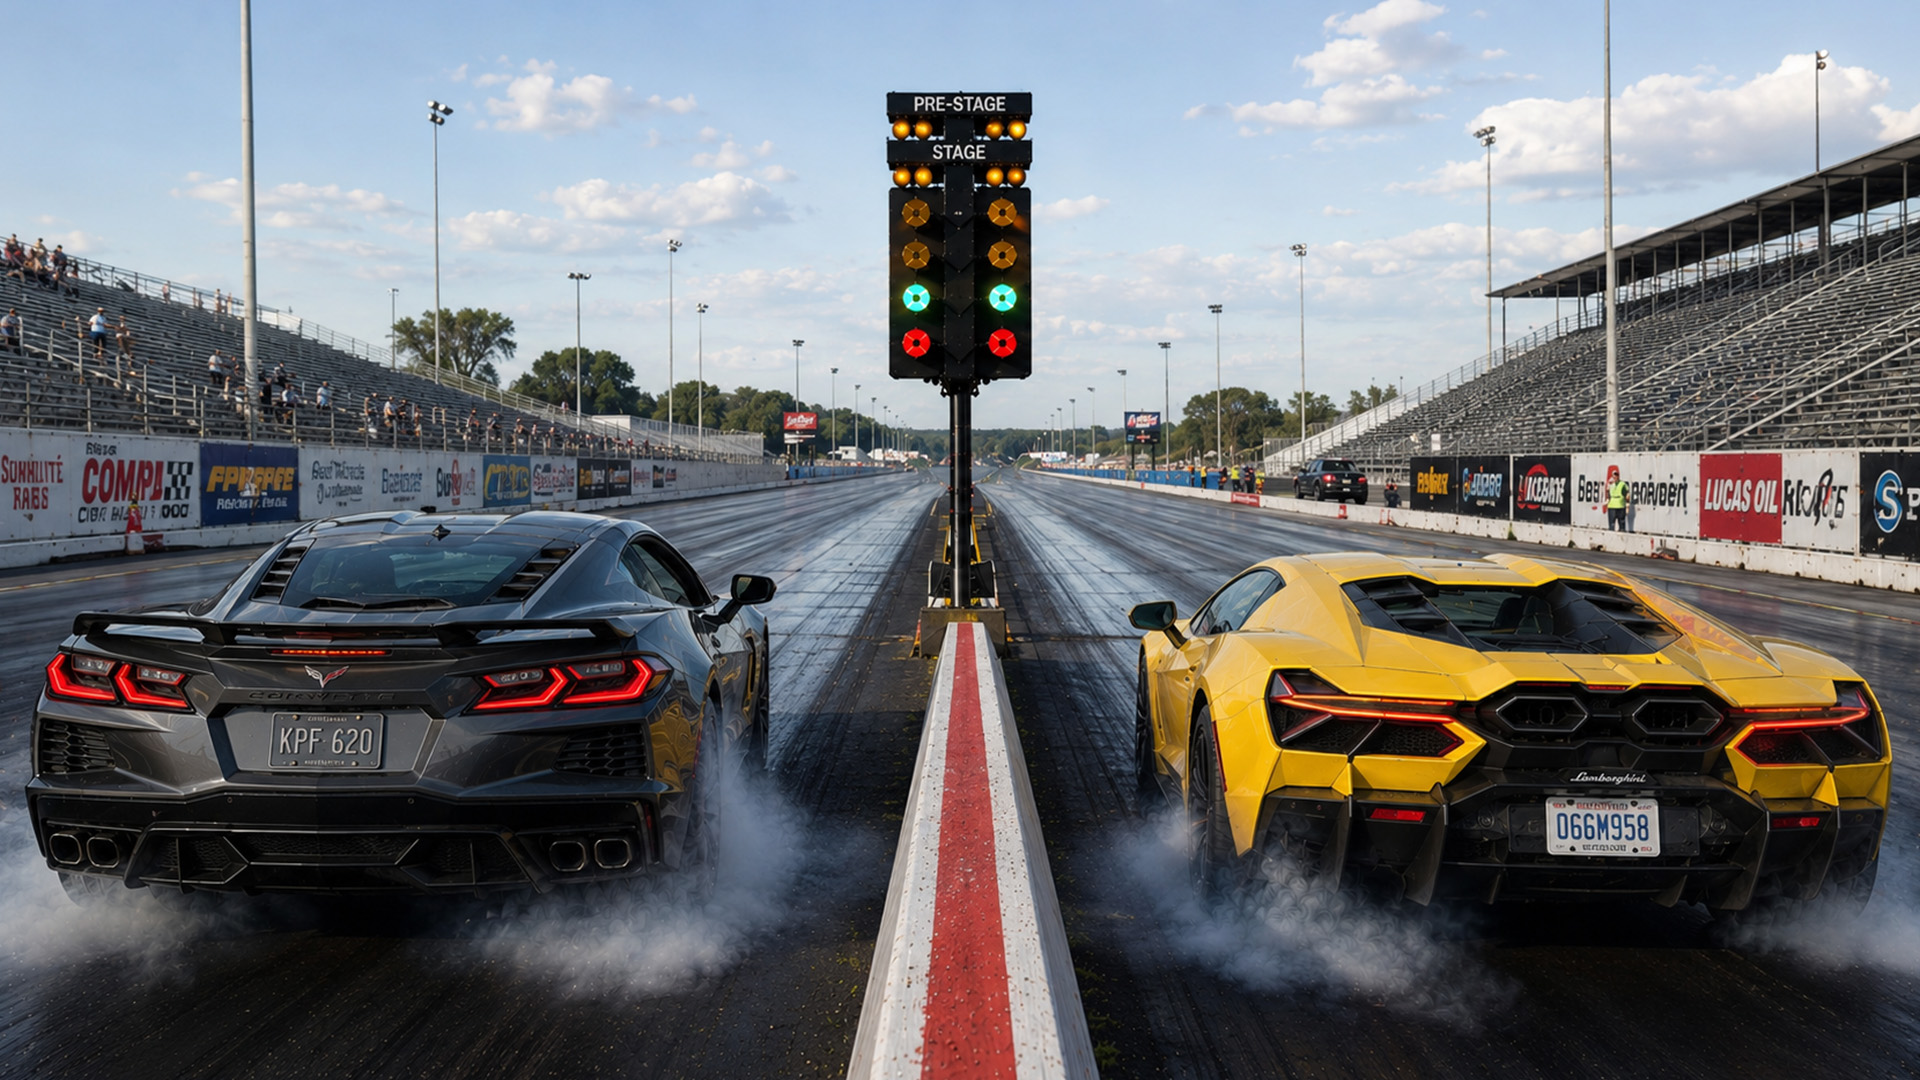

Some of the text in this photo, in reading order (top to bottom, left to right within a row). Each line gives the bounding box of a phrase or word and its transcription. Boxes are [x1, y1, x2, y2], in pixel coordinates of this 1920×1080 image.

[914, 96, 1006, 112] PRE-STAGE
[932, 144, 986, 160] STAGE
[1704, 478, 1751, 513] LUCAS
[1754, 479, 1778, 514] OIL
[279, 727, 373, 754] KPF 620
[1570, 771, 1646, 785] Lamborghini
